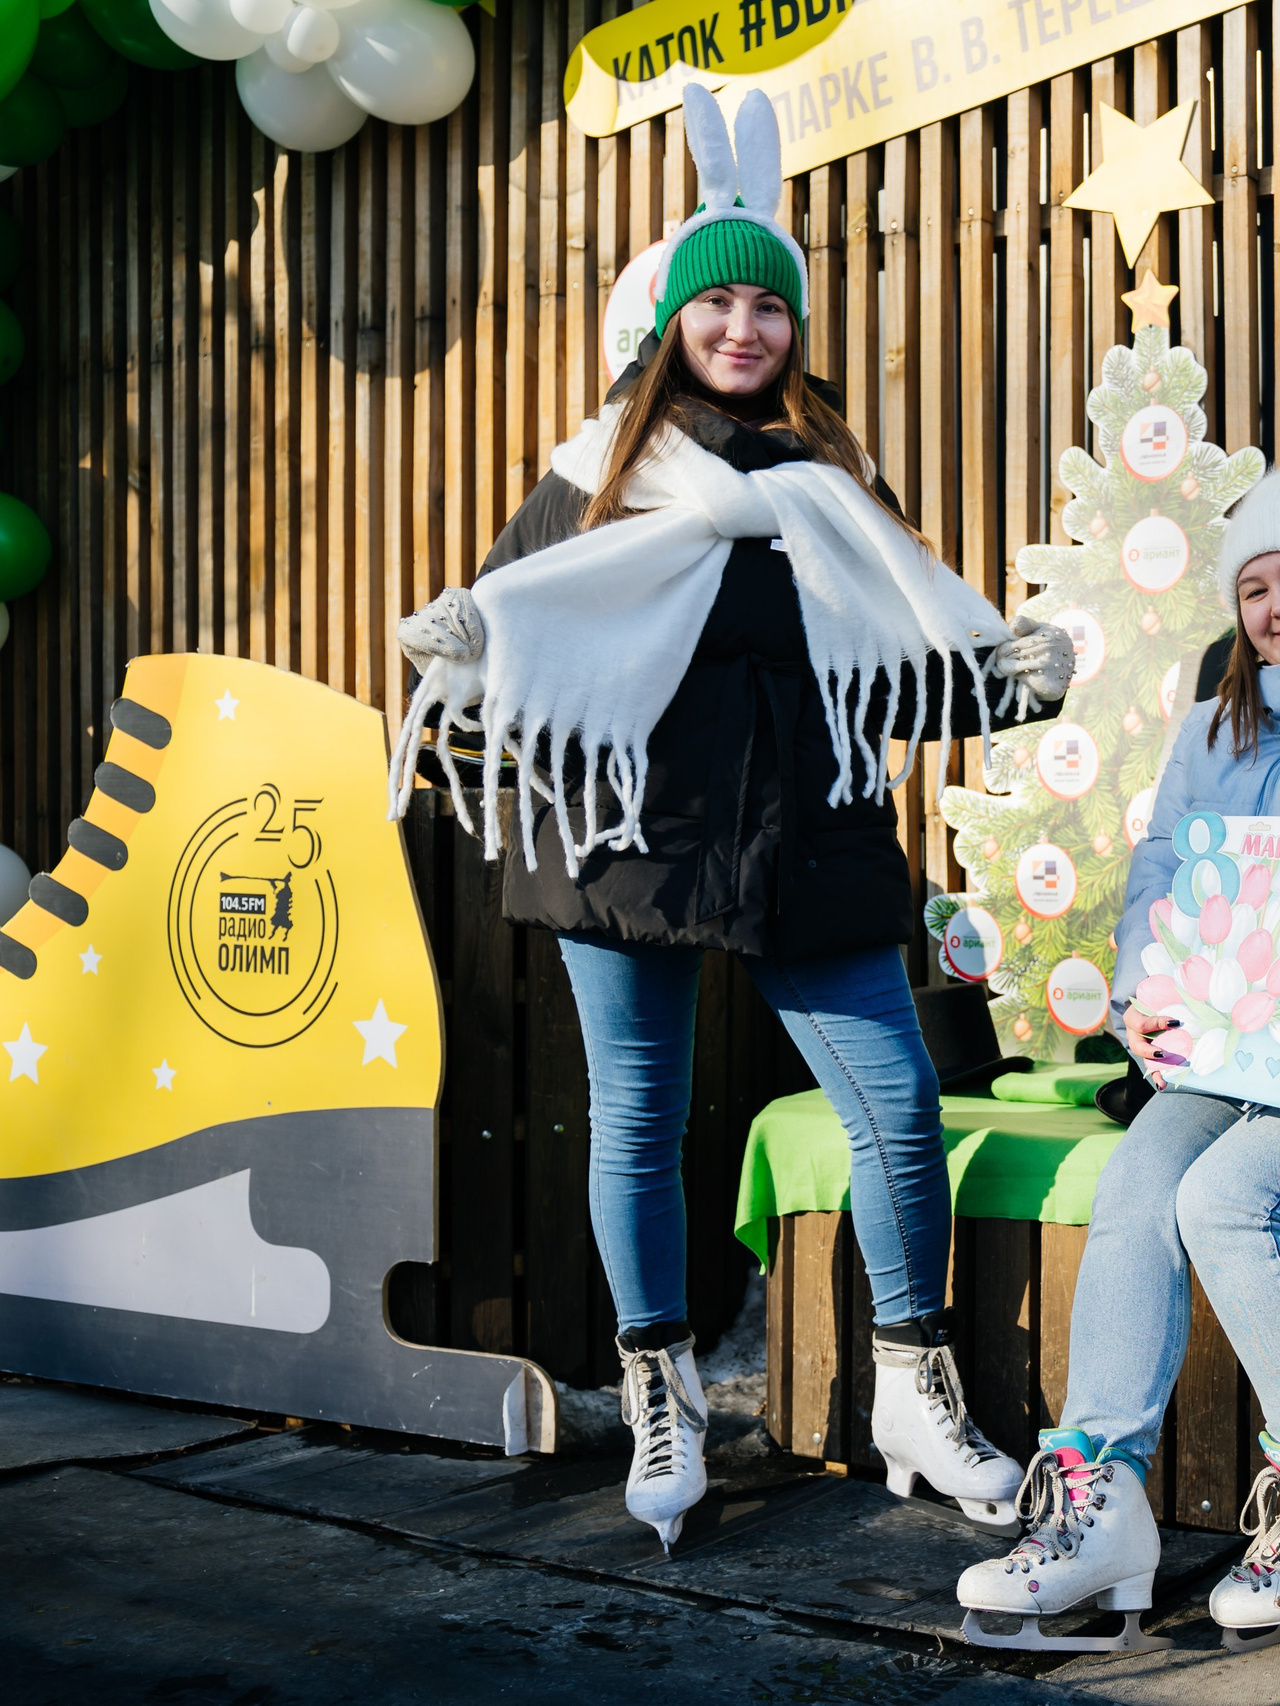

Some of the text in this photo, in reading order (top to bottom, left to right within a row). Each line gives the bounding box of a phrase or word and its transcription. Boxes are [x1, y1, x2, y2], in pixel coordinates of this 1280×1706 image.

[612, 12, 725, 107] КАТОК
[772, 51, 894, 144] ПАРКЕ
[910, 34, 951, 94] В.
[960, 15, 1003, 75] В.
[254, 783, 324, 870] 25
[1172, 810, 1242, 919] 8
[217, 943, 290, 975] ОЛИМП
[218, 916, 267, 941] радио
